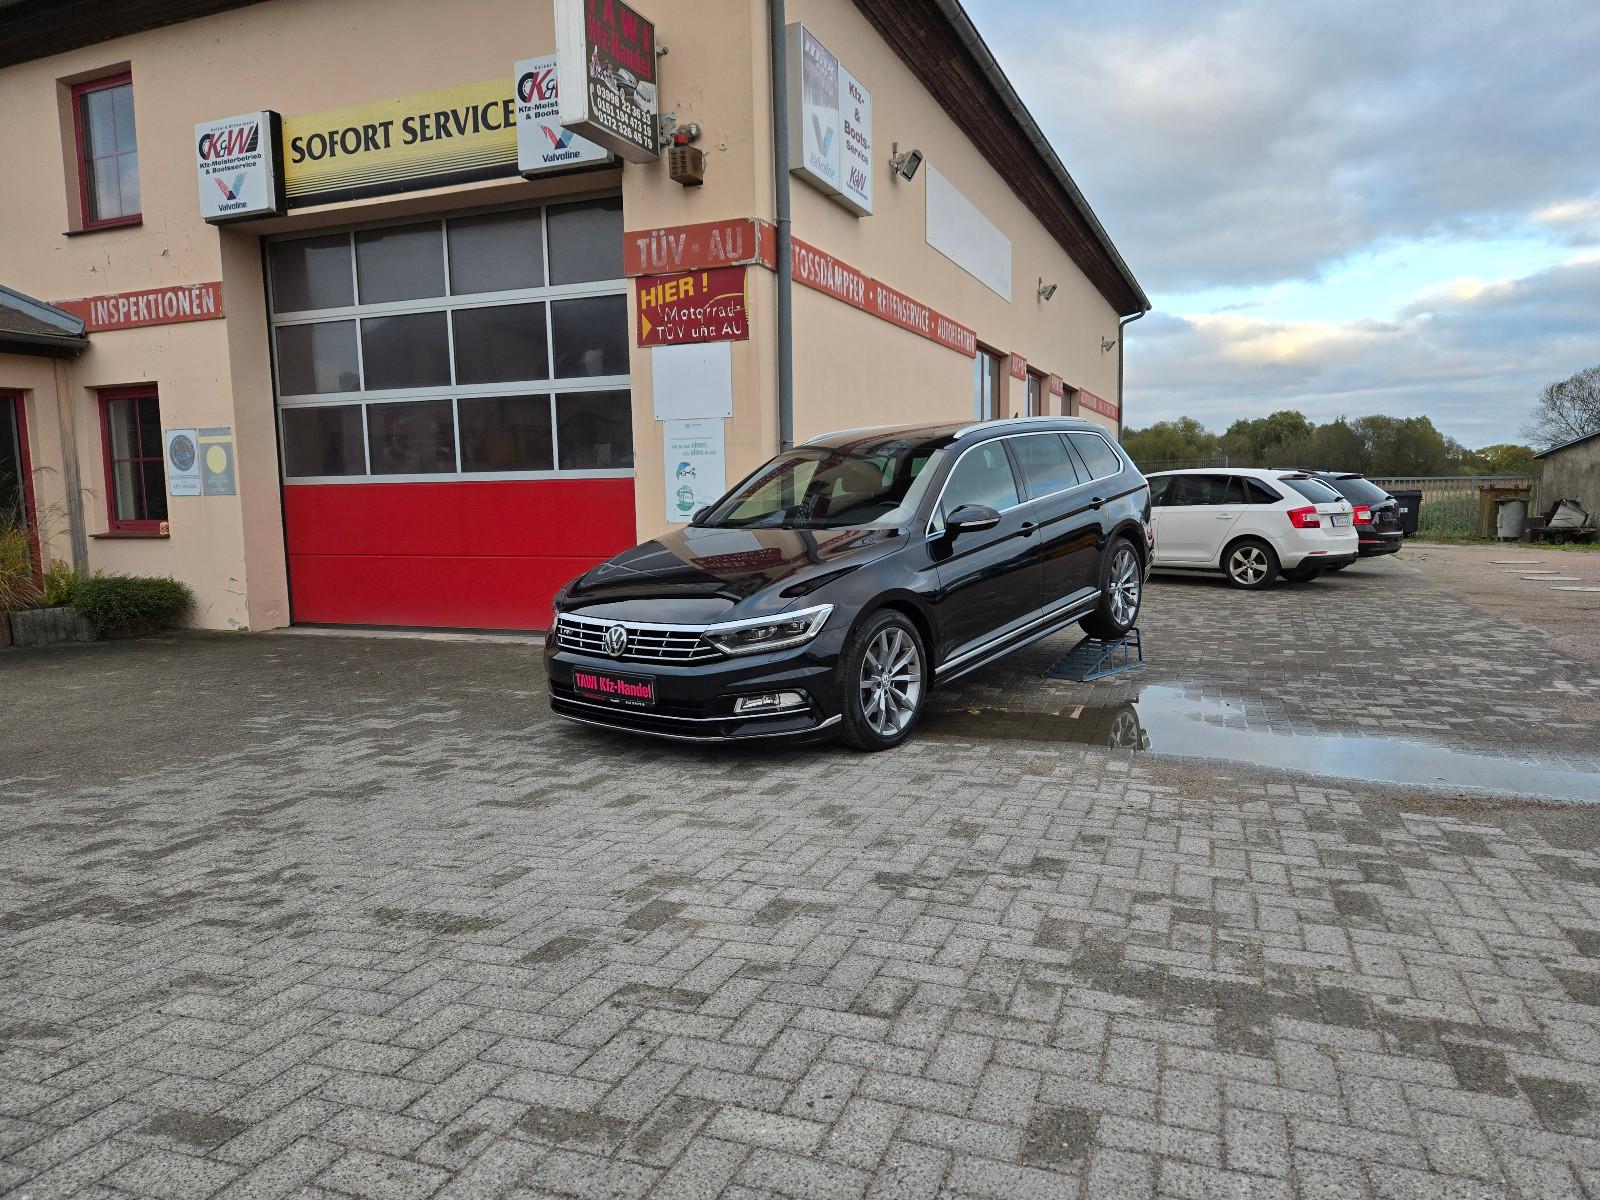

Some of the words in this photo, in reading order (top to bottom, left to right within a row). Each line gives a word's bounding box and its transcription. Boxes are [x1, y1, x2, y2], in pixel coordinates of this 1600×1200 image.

[588, 14, 651, 80] Kfz-Handel
[597, 84, 620, 107] 03998
[621, 100, 631, 114] 22
[641, 111, 651, 125] 33
[849, 81, 865, 104] Kfz-
[518, 101, 559, 114] Kfz-Meist
[534, 109, 560, 119] Boots
[597, 98, 615, 117] 0151
[630, 117, 642, 132] 473
[643, 124, 652, 137] 19
[854, 108, 861, 124] &
[291, 120, 394, 164] SOFORT
[402, 98, 517, 145] SERVICE
[598, 110, 618, 130] 0172
[643, 136, 652, 149] 79
[844, 119, 870, 150] Boots-
[199, 153, 262, 169] Kfz-Meisterbetrieb
[542, 150, 581, 162] Valvoline
[846, 139, 869, 165] Service
[212, 161, 257, 174] Bootsservice
[218, 201, 248, 212] Valvoline
[636, 229, 686, 269] TÜV
[707, 226, 743, 261] AU
[90, 287, 215, 325] INSPEKTIONEN
[640, 276, 695, 310] HIER
[877, 286, 929, 333] REIFENSERVICE
[656, 323, 685, 340] TÜV
[721, 320, 743, 336] AU
[575, 673, 597, 690] TAWI
[600, 676, 652, 698] Kfz-Handel
